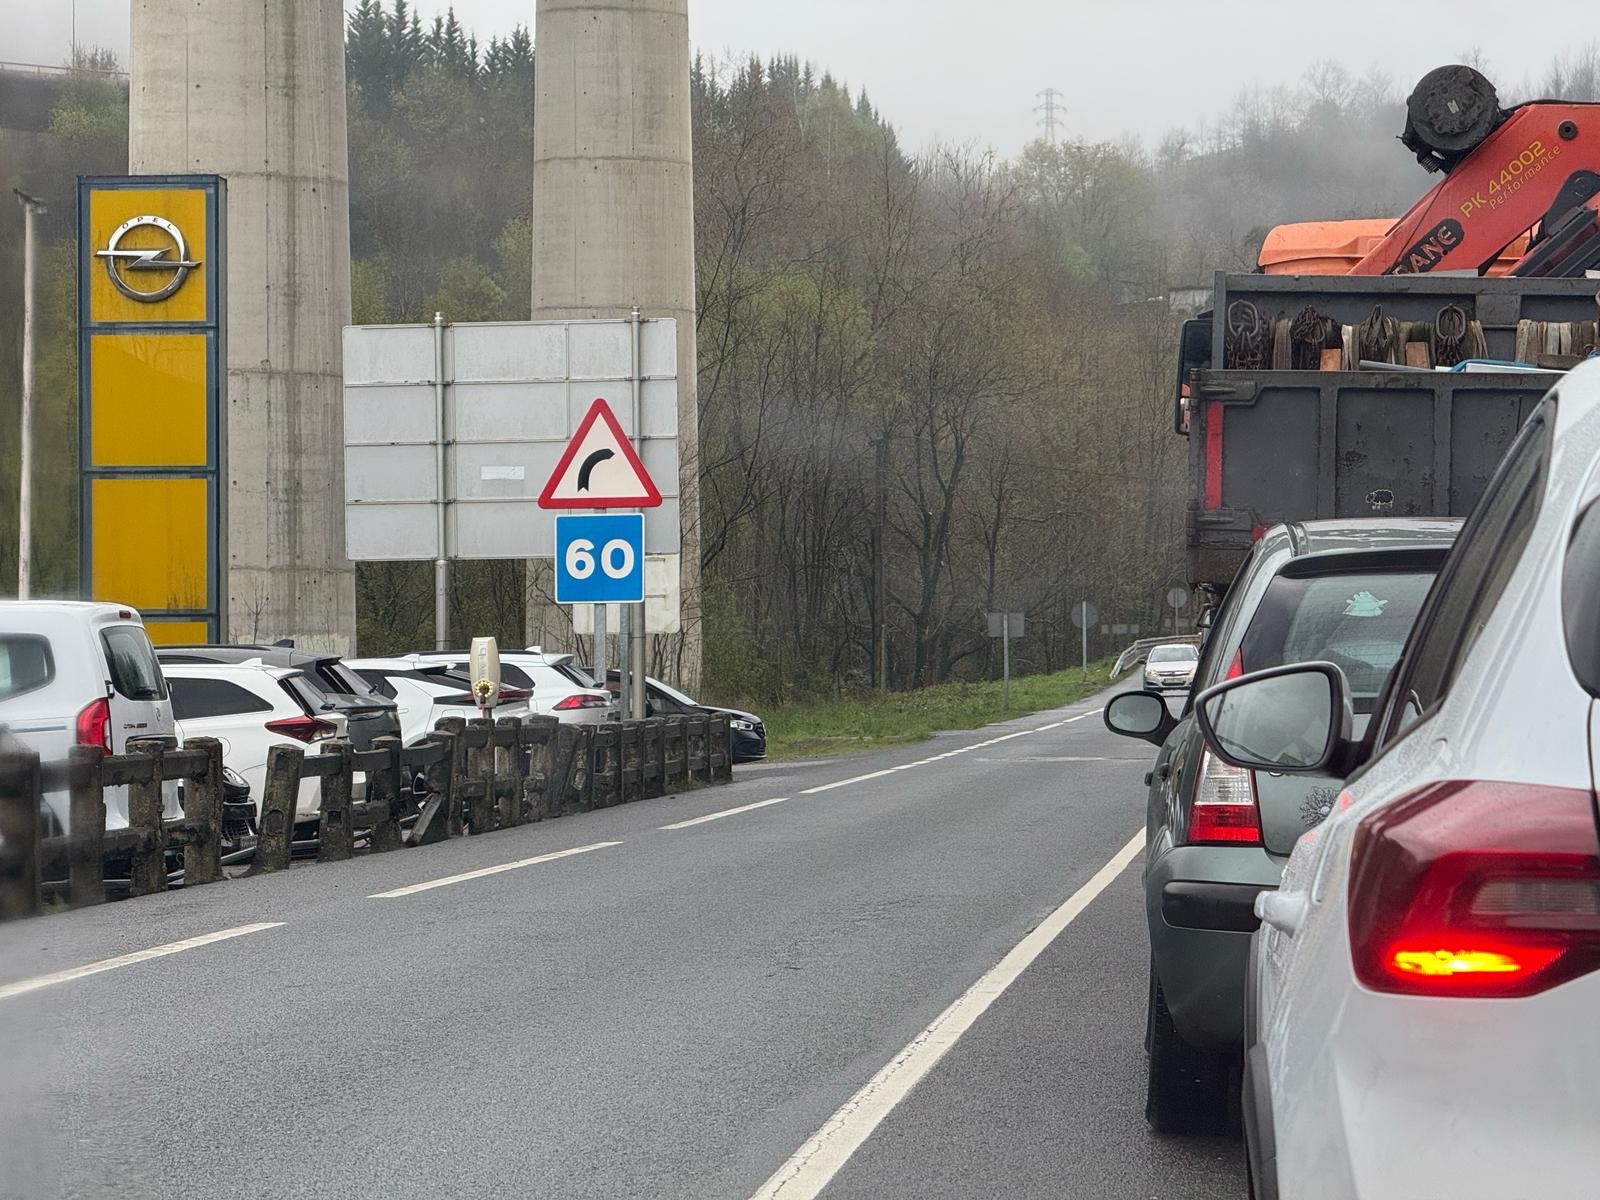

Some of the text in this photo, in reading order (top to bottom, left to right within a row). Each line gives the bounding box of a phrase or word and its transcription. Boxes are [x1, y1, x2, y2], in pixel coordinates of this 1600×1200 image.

[1460, 140, 1546, 218] PK 44002
[1489, 144, 1561, 210] Performance
[122, 216, 172, 230] OPEL
[565, 538, 635, 580] 60
